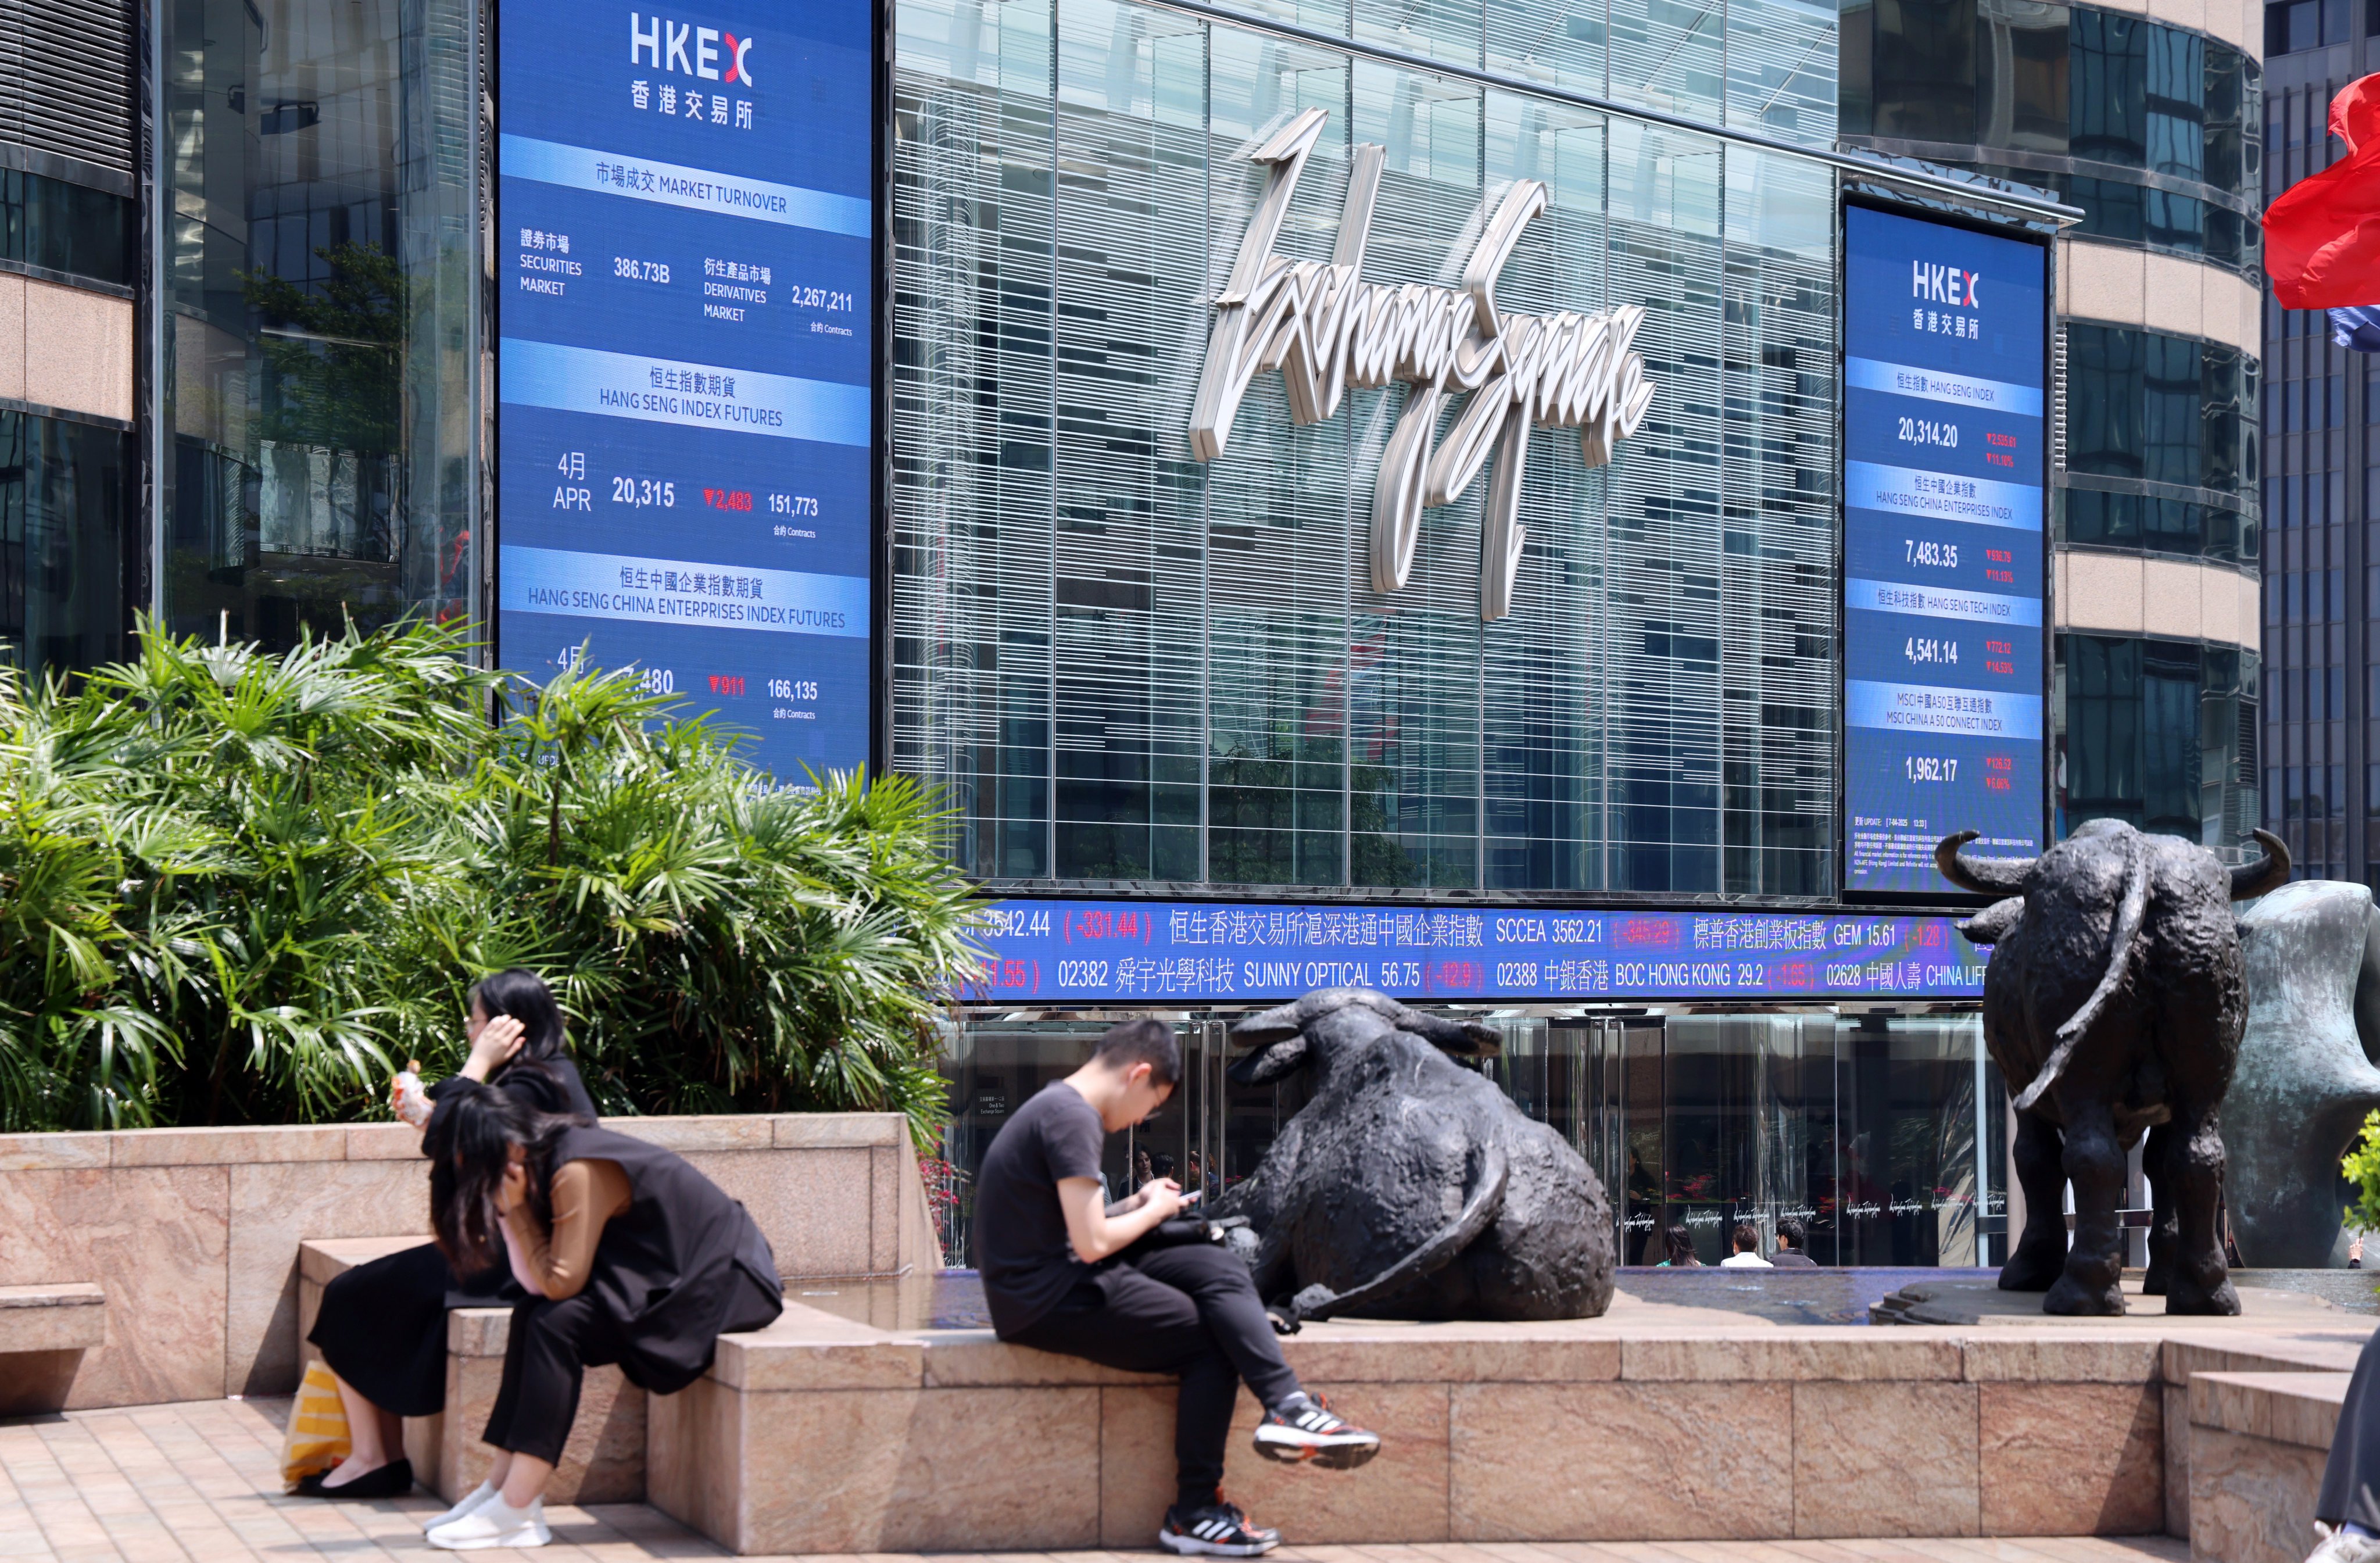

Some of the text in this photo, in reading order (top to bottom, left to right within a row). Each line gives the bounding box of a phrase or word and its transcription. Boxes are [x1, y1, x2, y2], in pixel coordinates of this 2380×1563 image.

[631, 12, 752, 87] HKEX
[631, 80, 752, 130] 香港交易所
[596, 162, 787, 213] 市場成交 MARKET TURNOVER
[520, 254, 582, 276] SECURITIES
[614, 257, 670, 283] 386.73B
[704, 257, 771, 285] 衍生產品市場
[520, 276, 565, 296] MARKET
[704, 282, 767, 304] DERIVATIVES
[792, 285, 852, 312] 2,267,211
[1913, 260, 1978, 309] HKEX
[704, 303, 745, 321] MARKET
[1913, 309, 1978, 339] 香港交易所
[810, 321, 853, 336] 合約 Contracts
[650, 366, 735, 399] 恒生指數期貨
[1897, 371, 1994, 402] 恒生指數 HANG SENG INDEX
[600, 388, 782, 427] HANG SENG INDEX FUTURES
[1899, 417, 1957, 448] 20,314.20
[558, 452, 585, 481] 4月
[553, 486, 592, 512] APR
[612, 477, 675, 508] 20,315
[1914, 474, 1976, 499] 恒生中國企業指數
[716, 490, 753, 512] 2,483
[768, 493, 818, 517] 151,773
[1877, 491, 2013, 520] HANG SENG CHINA ENTERPRISES INDEX
[773, 525, 816, 539] 合約 Contracts
[1906, 539, 1957, 567] 7,483.35
[620, 565, 763, 599] 恒生中國企業指數期貨
[529, 588, 845, 628] HANG SENG CHINA ENTERPRISES INDEX FUTURES
[1878, 588, 2011, 616] 恒生科技指數 HANG SENG TECH INDEX
[1905, 637, 1957, 664] 4,541.14
[721, 676, 745, 696] 911
[768, 679, 818, 702] 166,135
[773, 708, 815, 720] 合約 Contracts
[1887, 711, 2002, 731] MSCI CHINA A 50 CONNECT INDEX
[1906, 756, 1957, 784] 1,962.17
[983, 910, 1050, 937] 3542.44
[1169, 909, 1483, 947] 恒生香港交易所滬深港通中國企業指數
[1496, 918, 1546, 943] SCCEA
[1552, 919, 1602, 943] 3562.21
[1693, 918, 1827, 950] 標普香港創業板指數
[1834, 924, 1861, 945] GEM
[1867, 924, 1895, 946] 15.61
[1058, 960, 1108, 987] 02382
[1115, 957, 1234, 993] 舜宇光學科技
[1244, 961, 1302, 987] SUNNY
[1305, 962, 1373, 986] OPTICAL
[1381, 963, 1420, 987] 56.75
[1497, 963, 1537, 987] 02388
[1544, 959, 1609, 992] 中銀香港
[1616, 963, 1645, 986] BOC
[1649, 963, 1688, 986] HONG
[1692, 963, 1730, 986] KONG
[1738, 964, 1763, 986] 29.2
[1826, 964, 1860, 986] 02628
[1866, 961, 1921, 991] 中國人壽
[1926, 965, 1963, 986] CHINA
